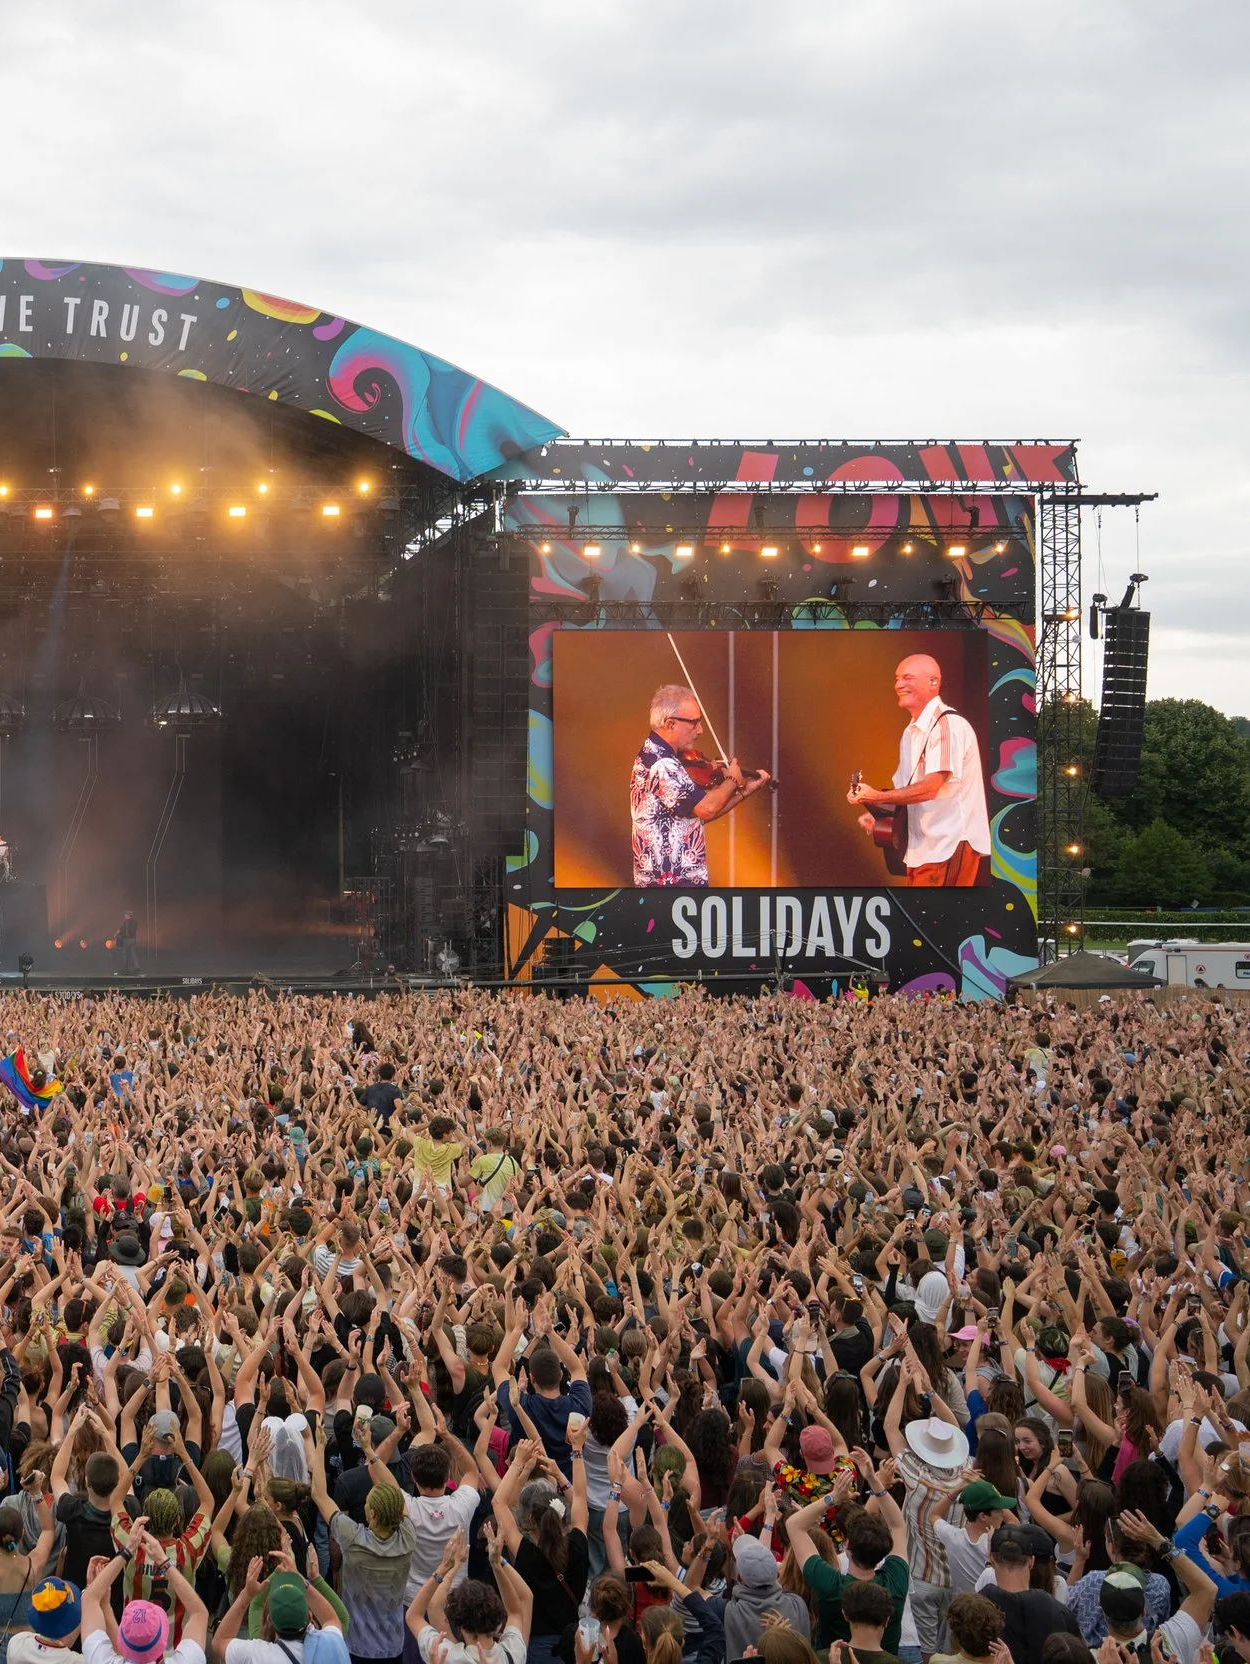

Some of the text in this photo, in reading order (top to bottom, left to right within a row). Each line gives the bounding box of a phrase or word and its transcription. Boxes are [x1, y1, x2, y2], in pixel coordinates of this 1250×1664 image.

[63, 297, 198, 351] TRUST
[671, 896, 891, 958] SOLIDAYS
[182, 977, 203, 985] SOLIDAYS
